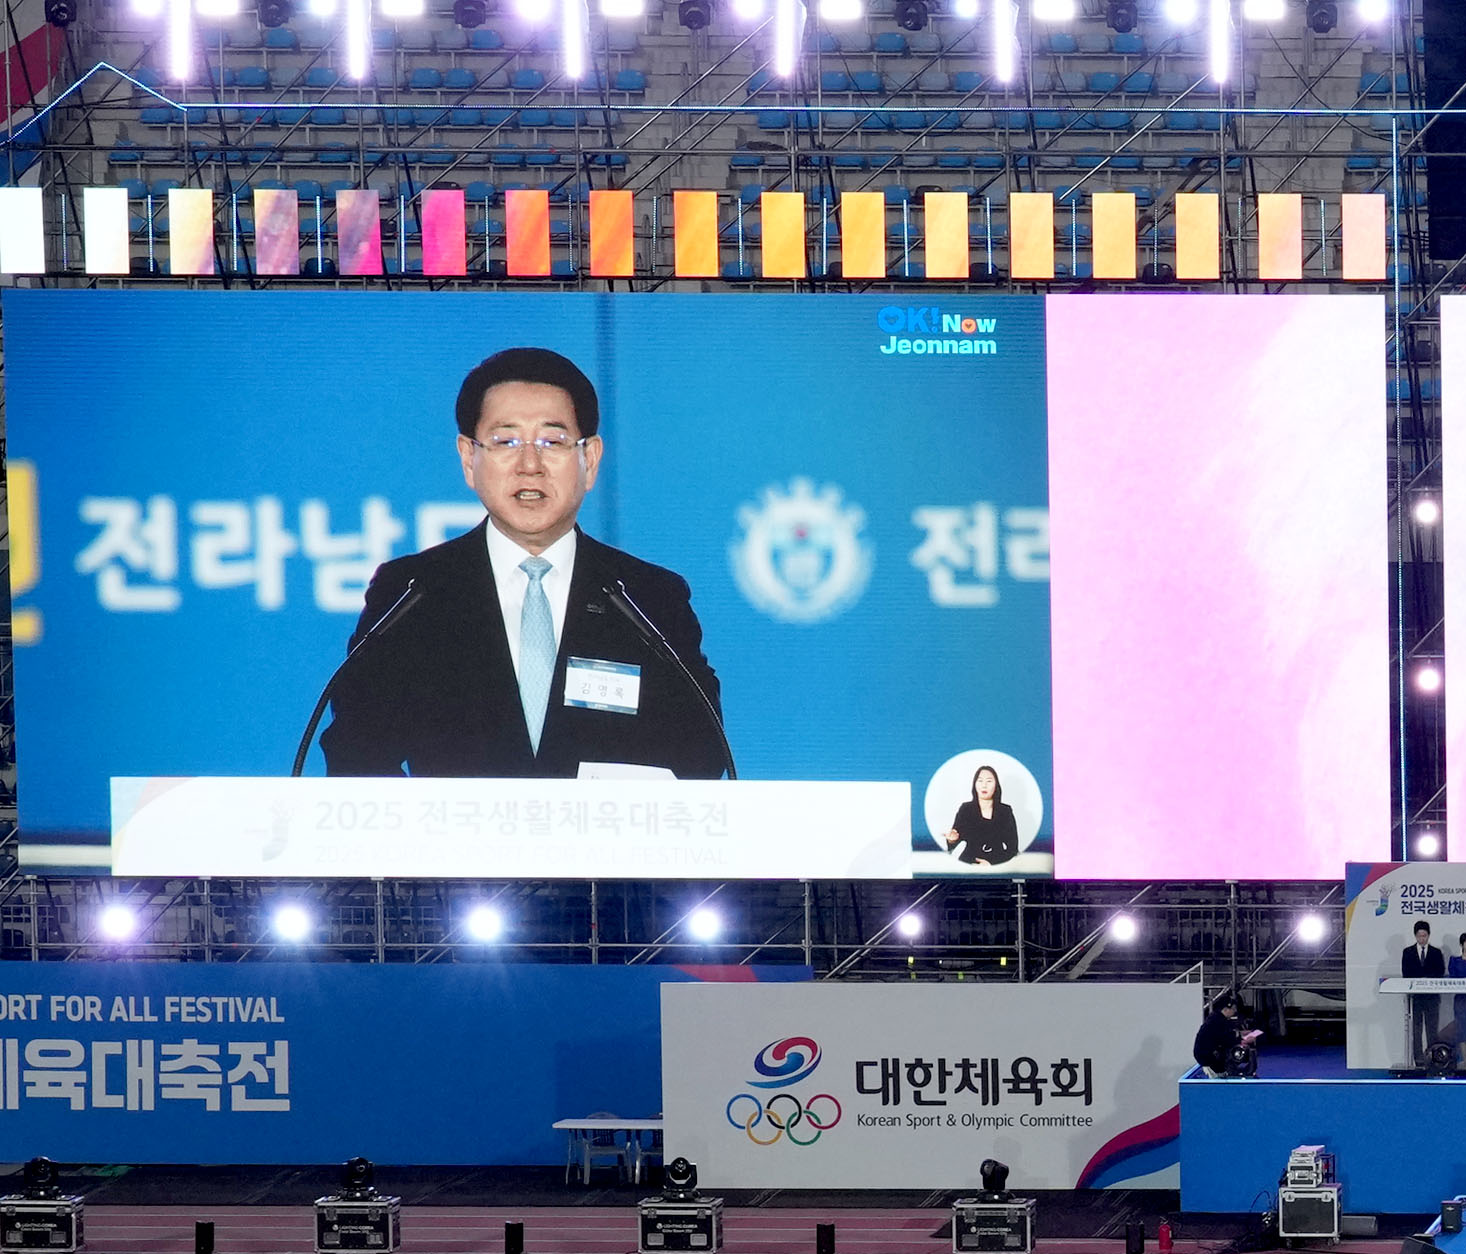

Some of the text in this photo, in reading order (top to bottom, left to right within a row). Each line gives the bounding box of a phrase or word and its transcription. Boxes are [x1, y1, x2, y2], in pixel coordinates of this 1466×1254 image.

[876, 304, 997, 335] OK! Now
[879, 334, 998, 357] Jeonnam
[315, 797, 730, 838] 2025 전국생활체육대축전
[1400, 884, 1435, 898] 2025
[50, 995, 102, 1022] FOR
[110, 995, 158, 1023] ALL
[165, 996, 286, 1023] FESTIVAL
[855, 1056, 1094, 1107] 대한체육회
[857, 1112, 1094, 1131] Korean Sport & Olympic Committee
